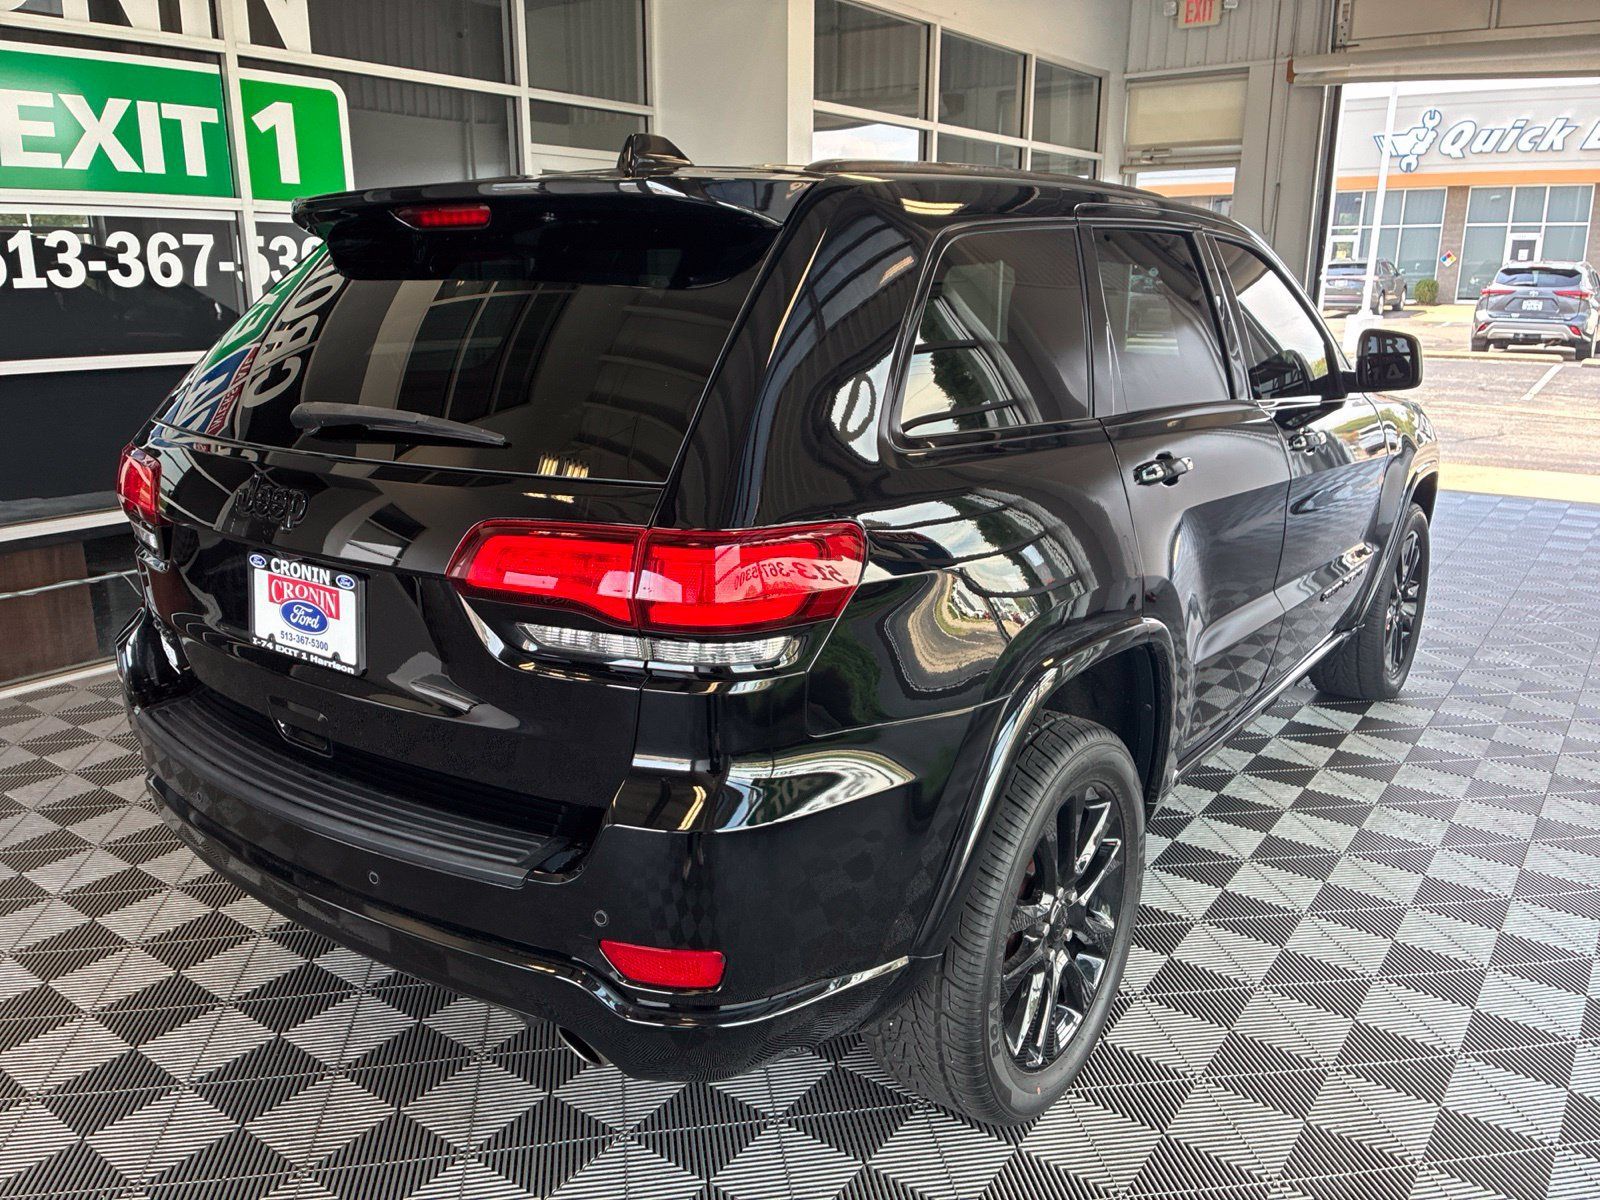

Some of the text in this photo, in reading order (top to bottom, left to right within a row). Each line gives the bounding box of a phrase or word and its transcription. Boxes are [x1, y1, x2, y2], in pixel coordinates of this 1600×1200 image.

[1184, 0, 1214, 23] EXIT
[0, 88, 300, 184] EXIT 1
[1439, 117, 1580, 159] Quick
[270, 557, 331, 586] CRONIN
[271, 579, 337, 617] CRONIN
[290, 604, 320, 629] Ford
[280, 631, 329, 651] 513-367-5300
[275, 644, 299, 658] EXIT
[301, 652, 308, 661] 1
[310, 654, 355, 674] Harrison
